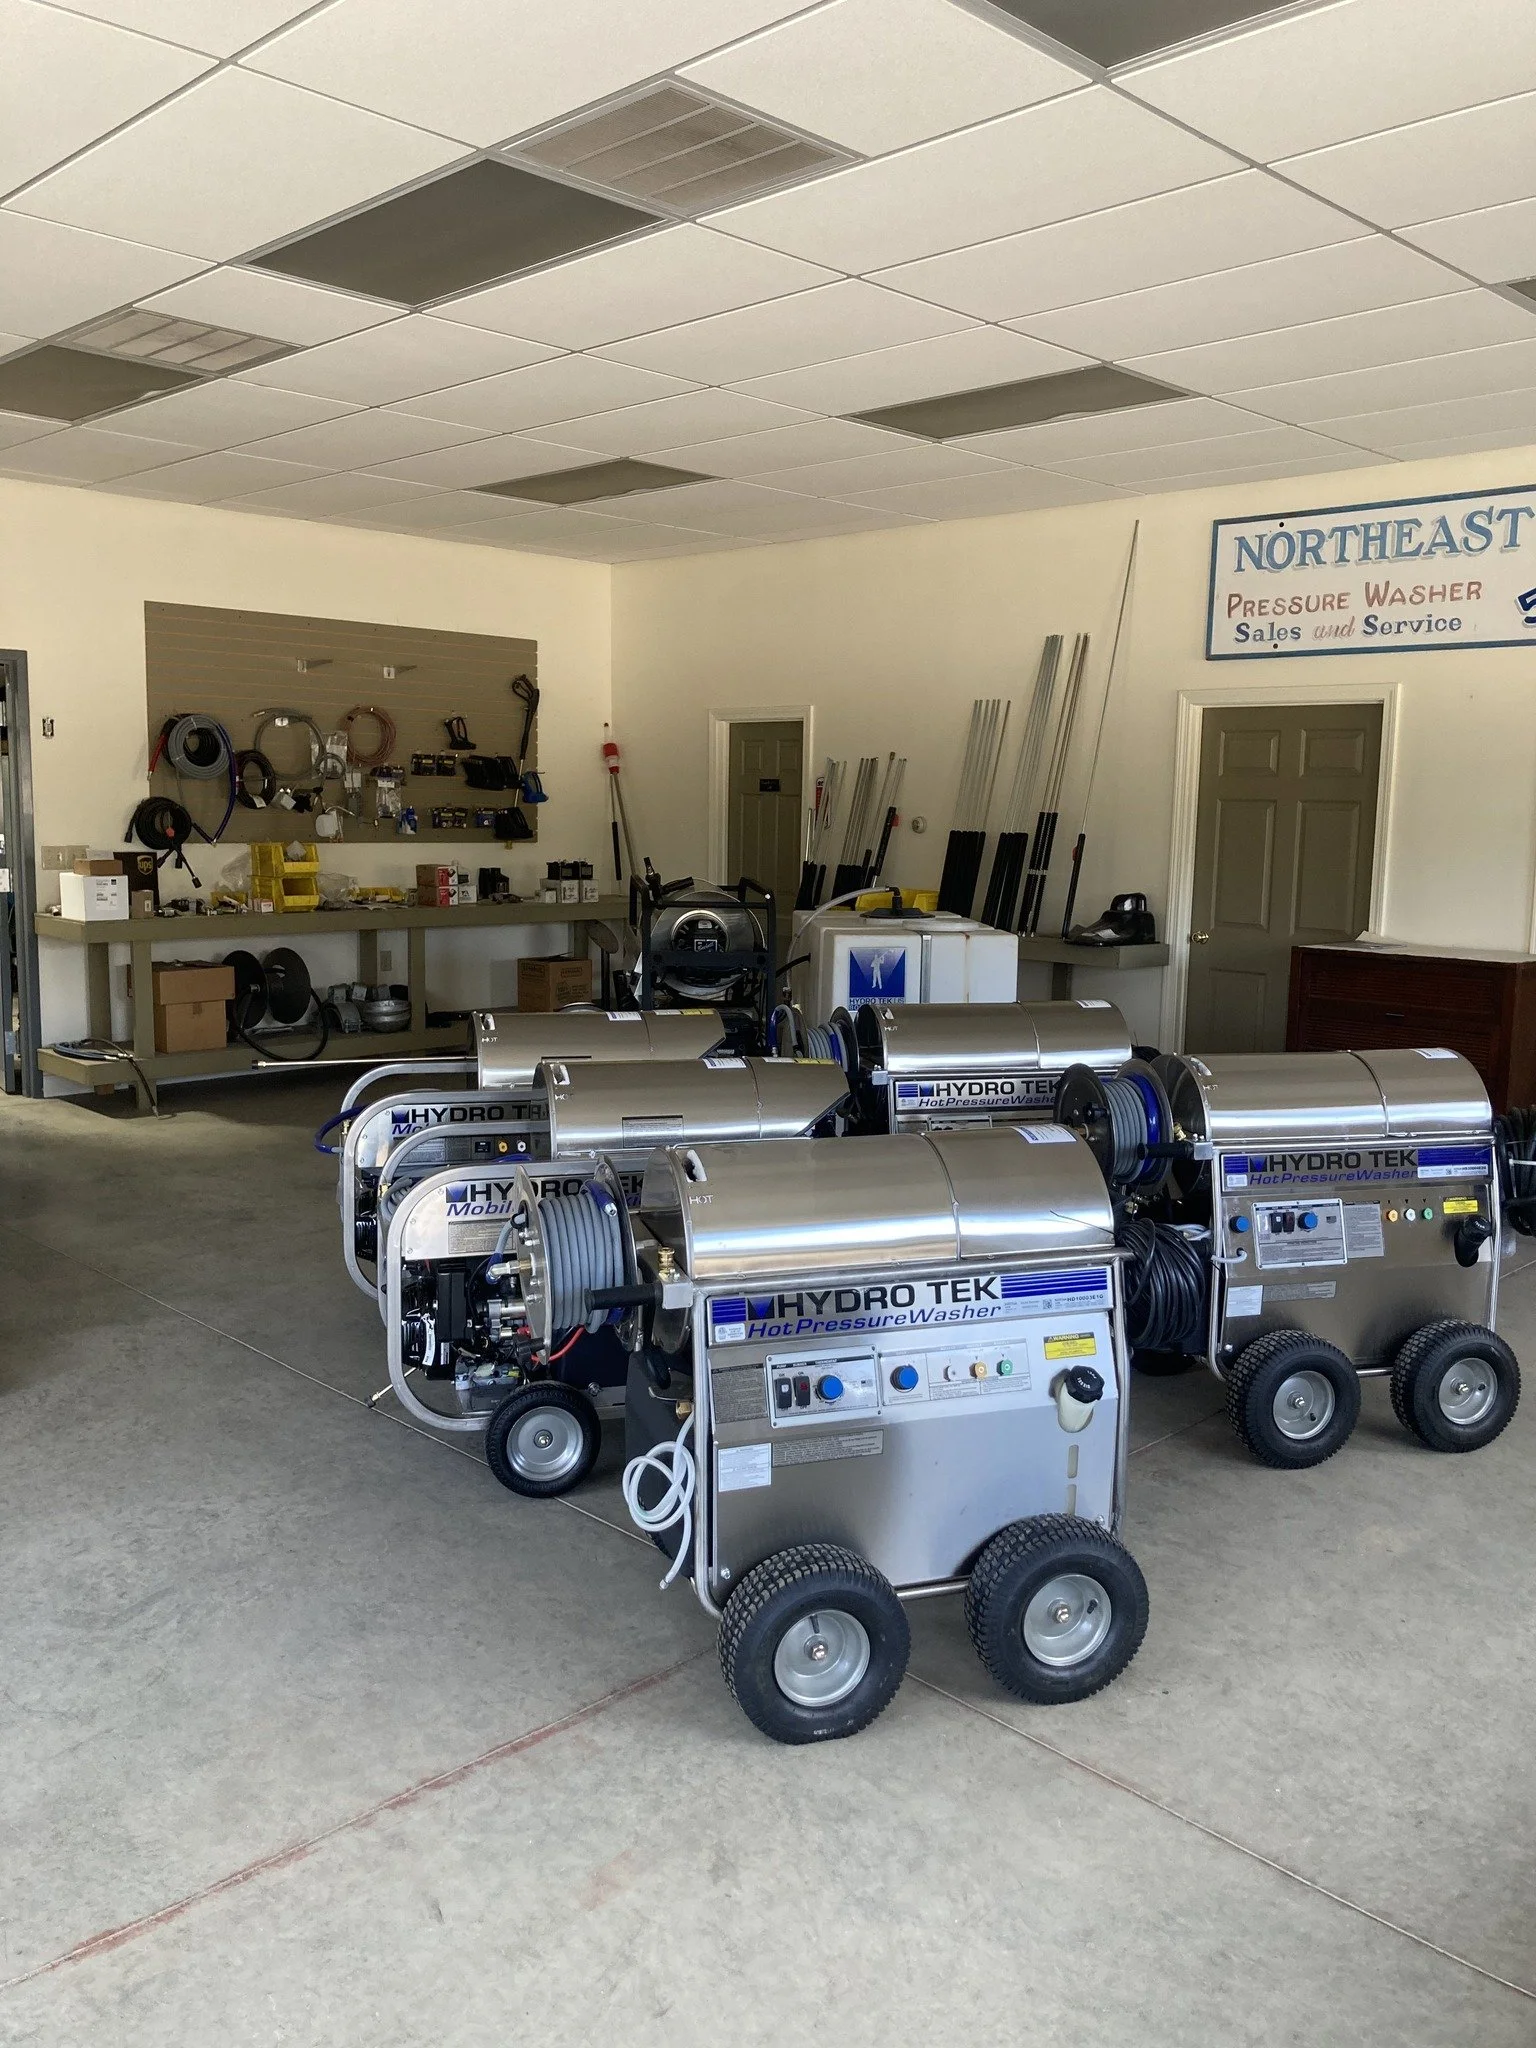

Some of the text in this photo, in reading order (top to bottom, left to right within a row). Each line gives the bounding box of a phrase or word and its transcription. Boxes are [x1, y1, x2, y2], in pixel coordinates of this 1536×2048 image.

[1234, 506, 1536, 573] NORTHEAST
[1226, 580, 1482, 618] PRESSURE WASHER
[1234, 613, 1462, 643] Sales and Service
[140, 861, 152, 872] ups
[936, 1081, 1014, 1097] HYDRO
[412, 1105, 505, 1123] HYDRO
[1269, 1150, 1417, 1172] HYDRO TEK
[689, 1194, 714, 1205] HOT
[777, 1276, 1000, 1319] HYDRO TEK
